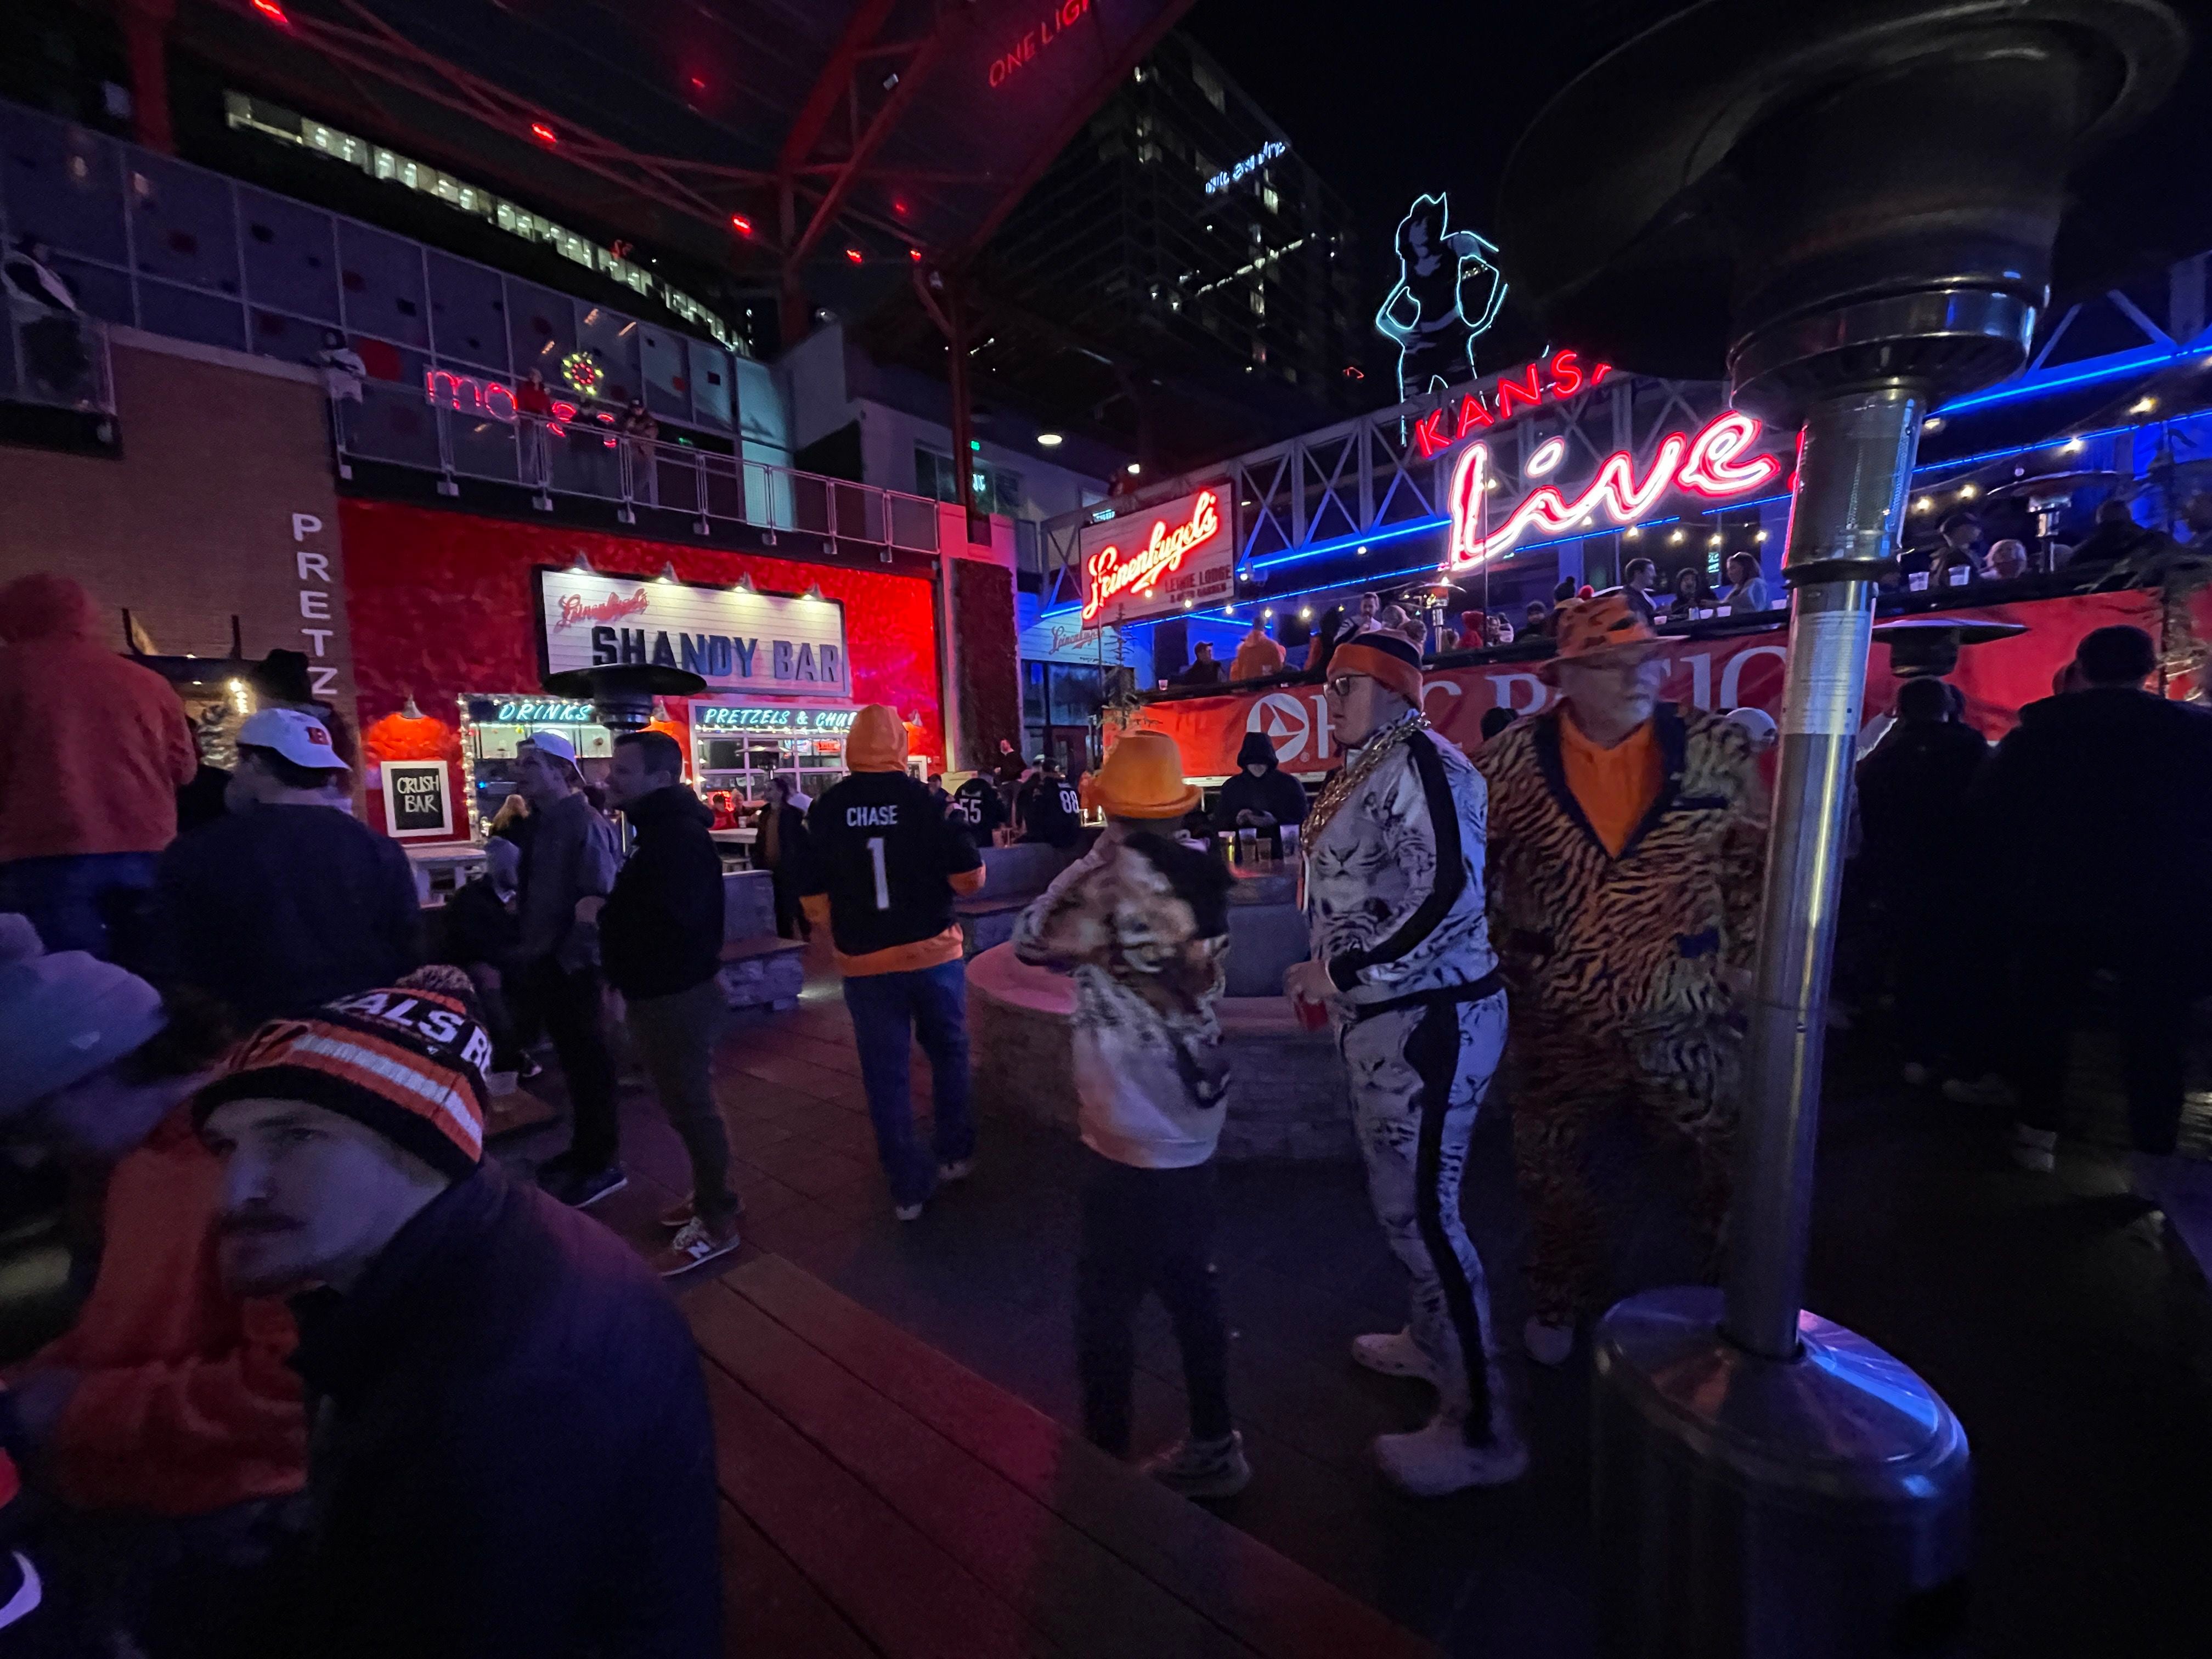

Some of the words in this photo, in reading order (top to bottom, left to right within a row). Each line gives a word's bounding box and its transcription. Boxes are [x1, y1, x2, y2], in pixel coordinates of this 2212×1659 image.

[989, 31, 1036, 87] ONE
[1414, 349, 1612, 458] KANS
[592, 626, 758, 677] SHANDY
[772, 640, 839, 681] BAR
[499, 703, 594, 720] DRINKS
[705, 708, 790, 725] PRETZELS
[797, 711, 808, 725] &
[397, 775, 439, 794] CRUSH
[405, 794, 438, 812] BAR
[1059, 790, 1080, 814] 88
[847, 805, 898, 827] CHASE
[866, 837, 890, 910] 1
